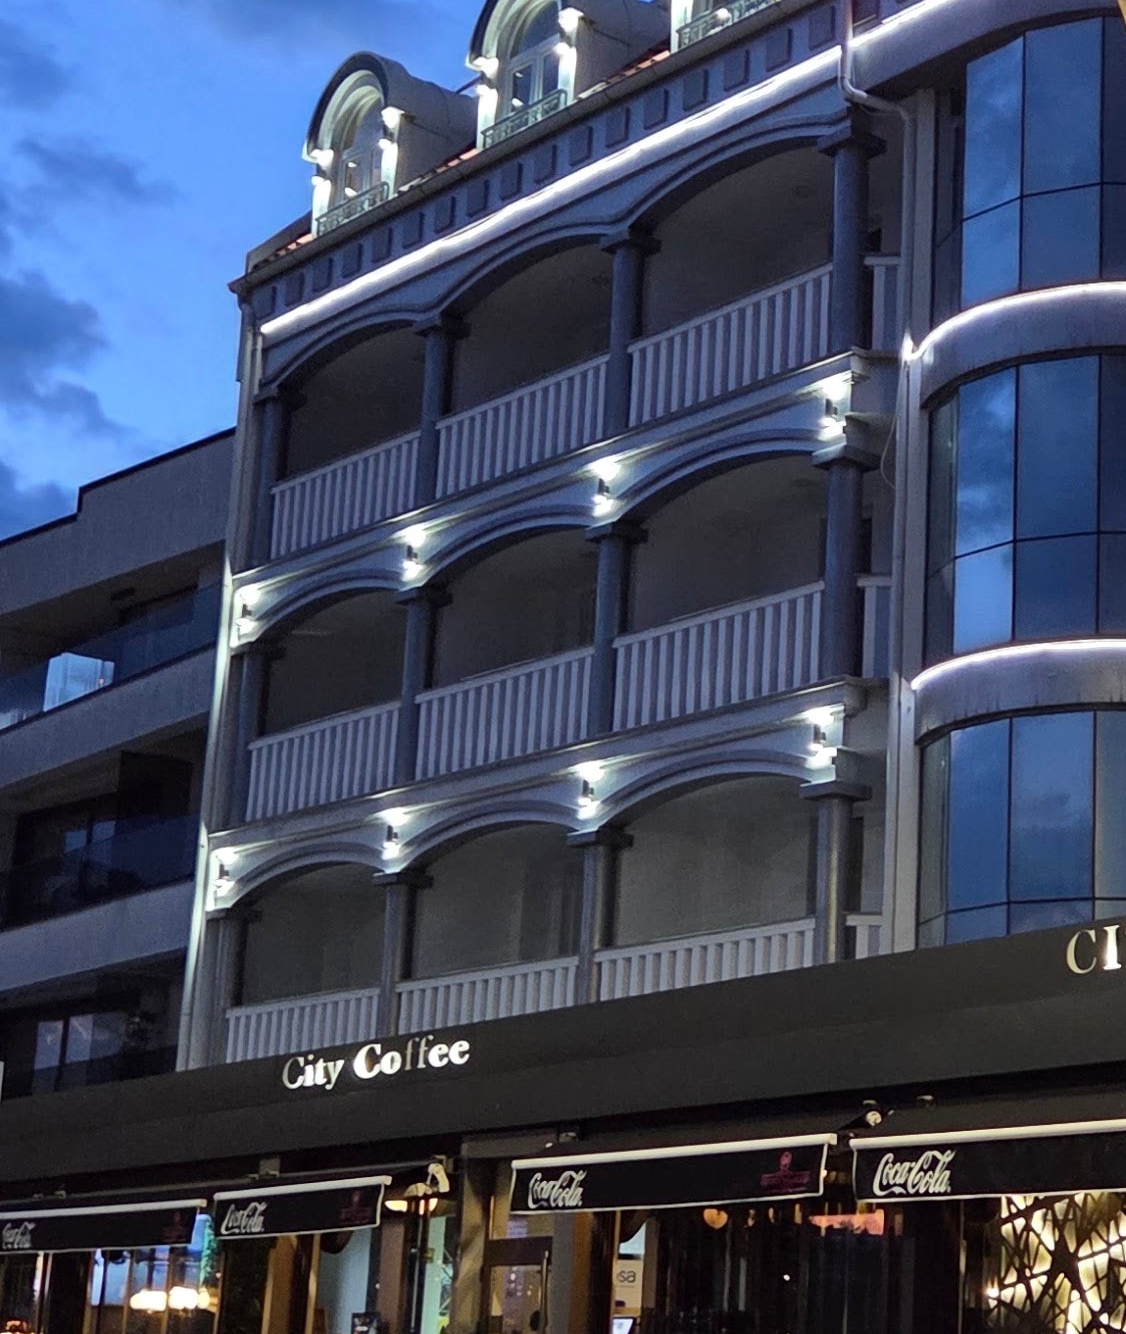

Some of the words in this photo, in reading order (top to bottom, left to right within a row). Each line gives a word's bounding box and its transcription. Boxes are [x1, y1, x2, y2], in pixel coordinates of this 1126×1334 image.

[282, 1054, 345, 1090] City
[353, 1034, 470, 1079] Coffee
[527, 1170, 587, 1209] Coca-Cola
[873, 1150, 956, 1197] Coca-Cola
